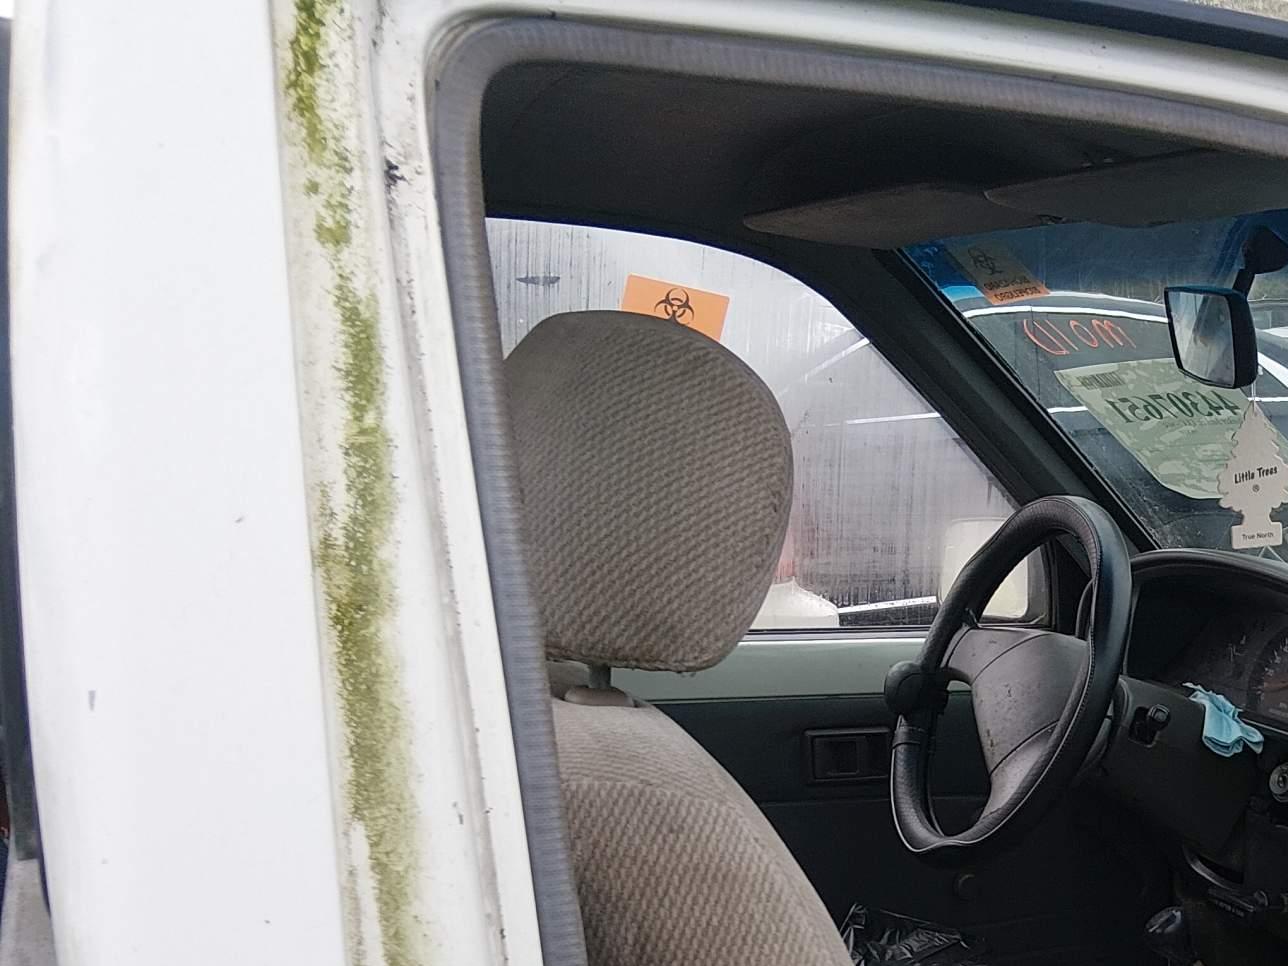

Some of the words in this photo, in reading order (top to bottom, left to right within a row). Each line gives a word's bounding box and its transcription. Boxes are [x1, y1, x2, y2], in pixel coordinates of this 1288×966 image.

[1234, 470, 1255, 484] Little
[1256, 466, 1278, 478] Trees
[1256, 531, 1274, 539] North
